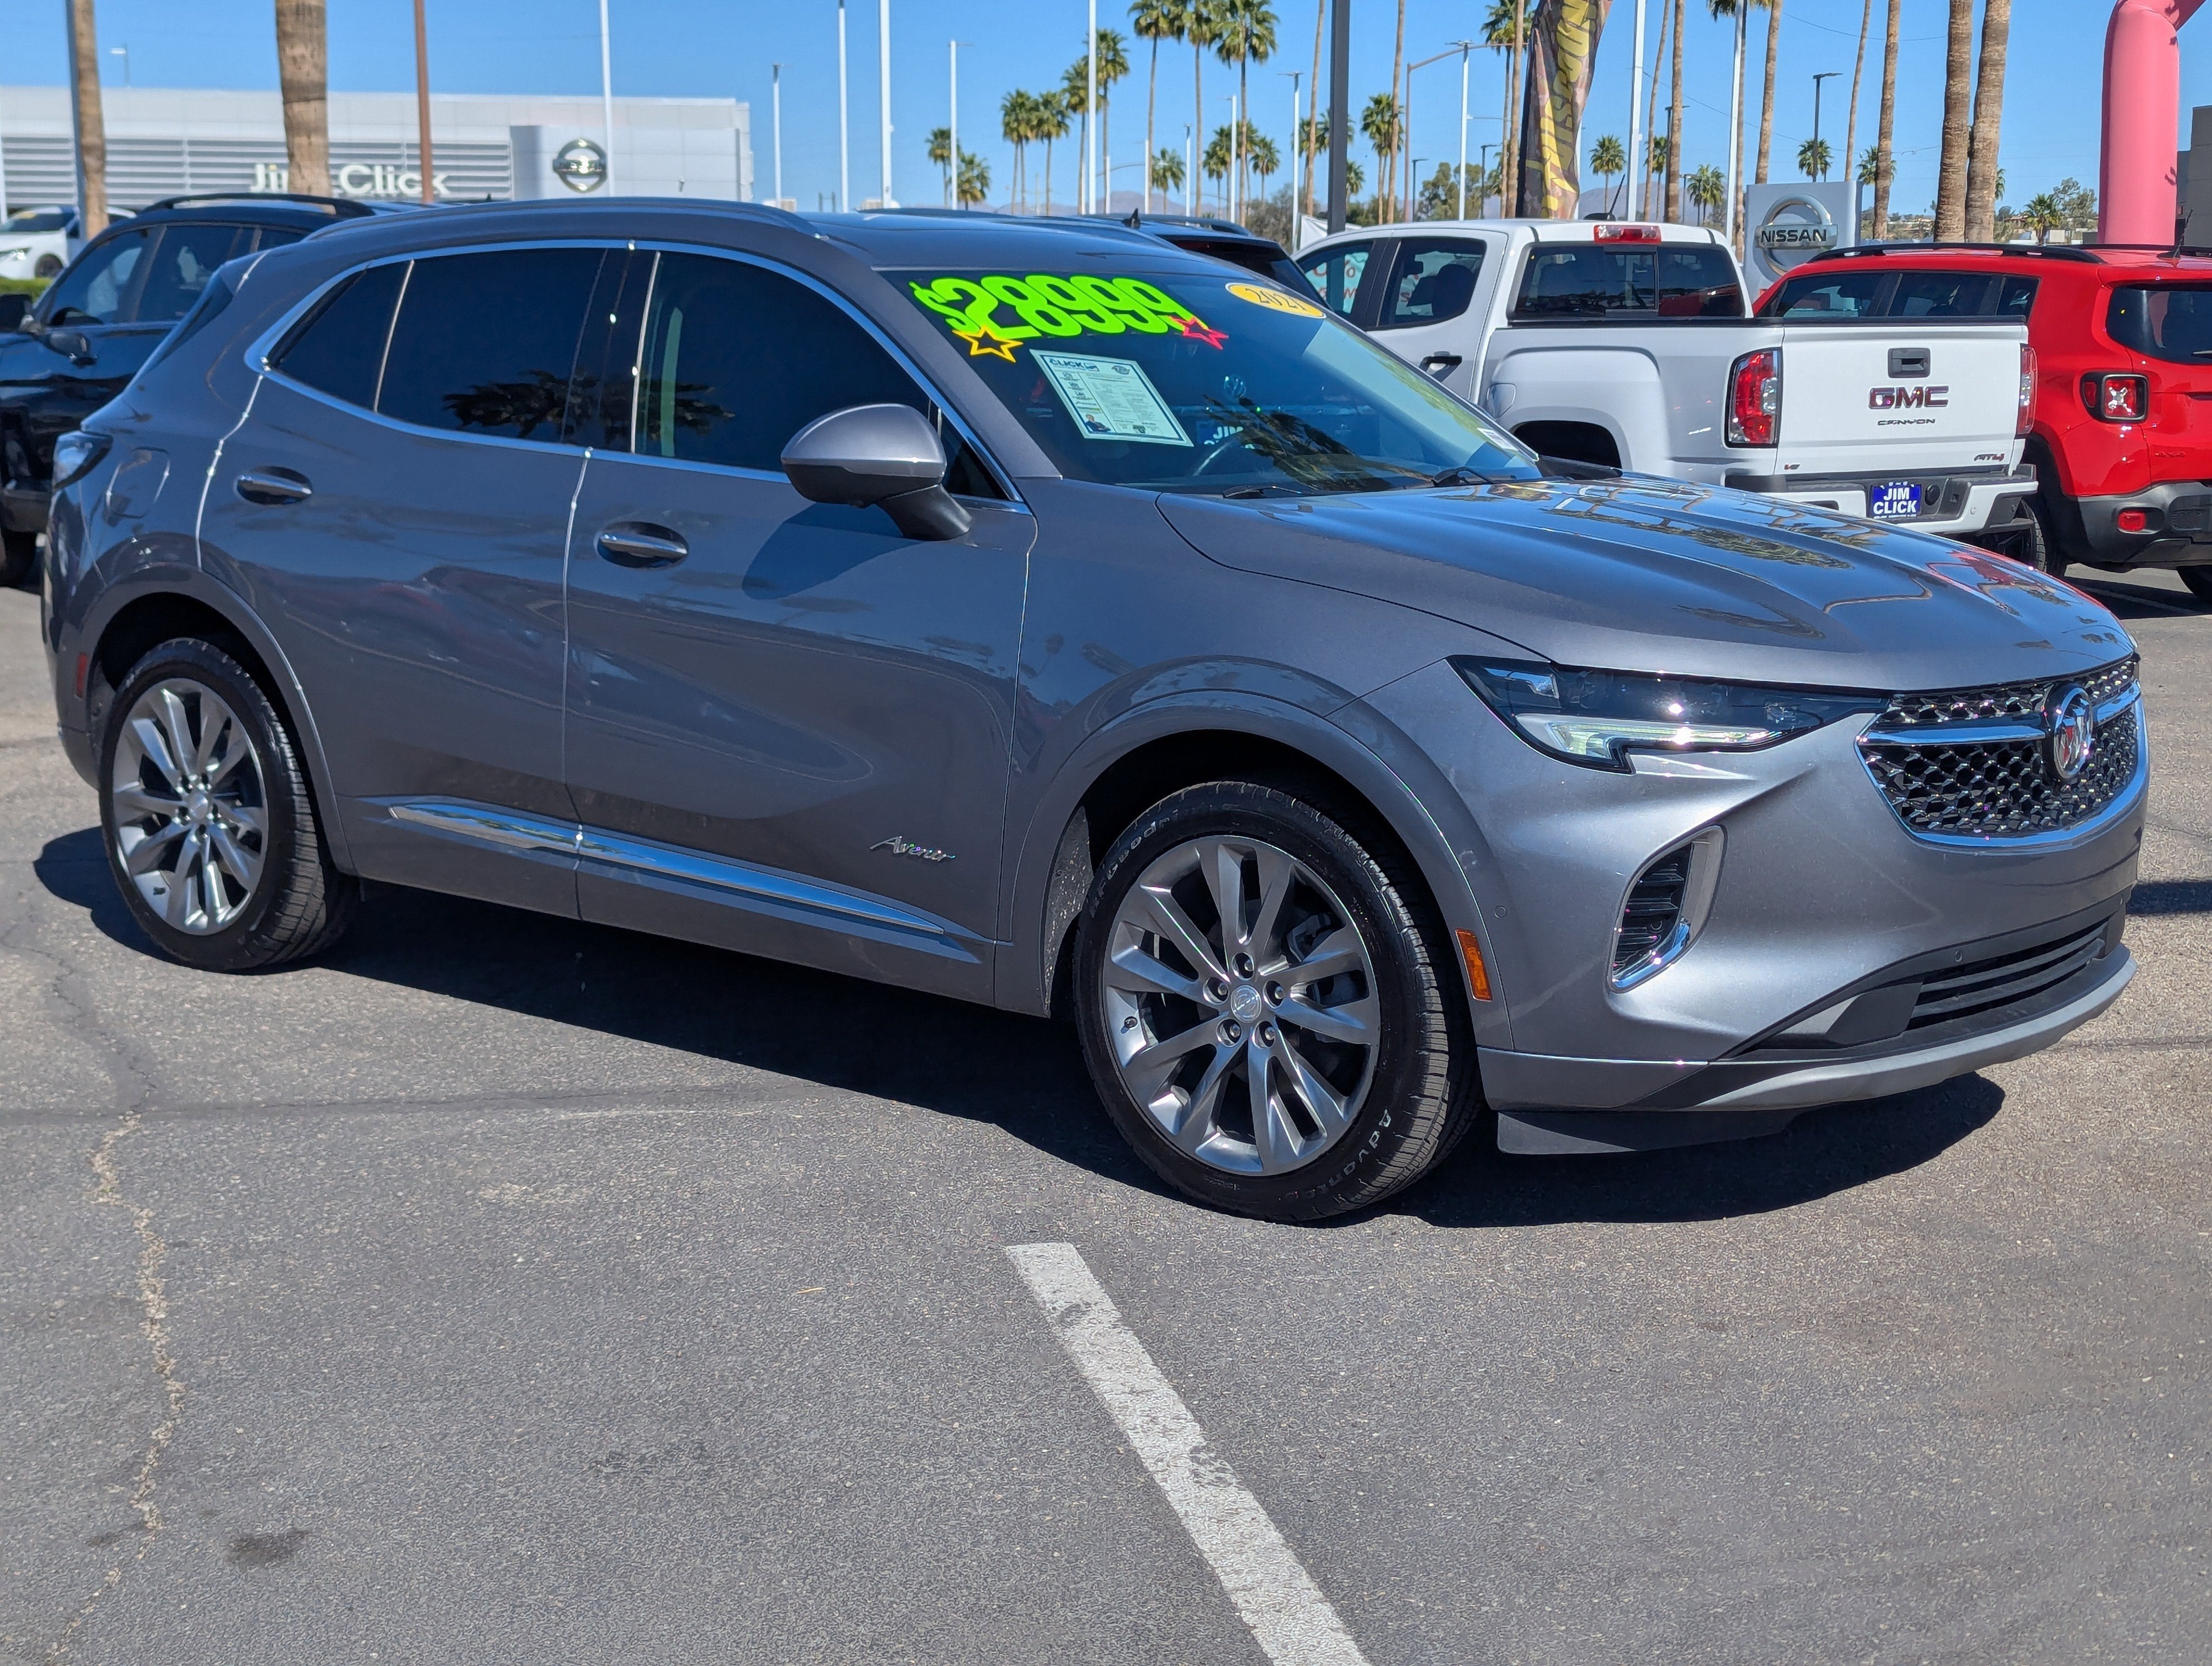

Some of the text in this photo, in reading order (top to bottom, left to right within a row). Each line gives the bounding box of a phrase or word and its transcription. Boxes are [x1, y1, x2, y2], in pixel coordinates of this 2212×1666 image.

[1761, 229, 1827, 242] NISSAN
[909, 275, 1209, 340] $28999
[1868, 386, 1949, 409] GMC
[1973, 453, 2005, 462] AT4
[1883, 487, 1910, 501] JIM
[1873, 500, 1917, 515] CLICK
[869, 836, 956, 861] Avenir
